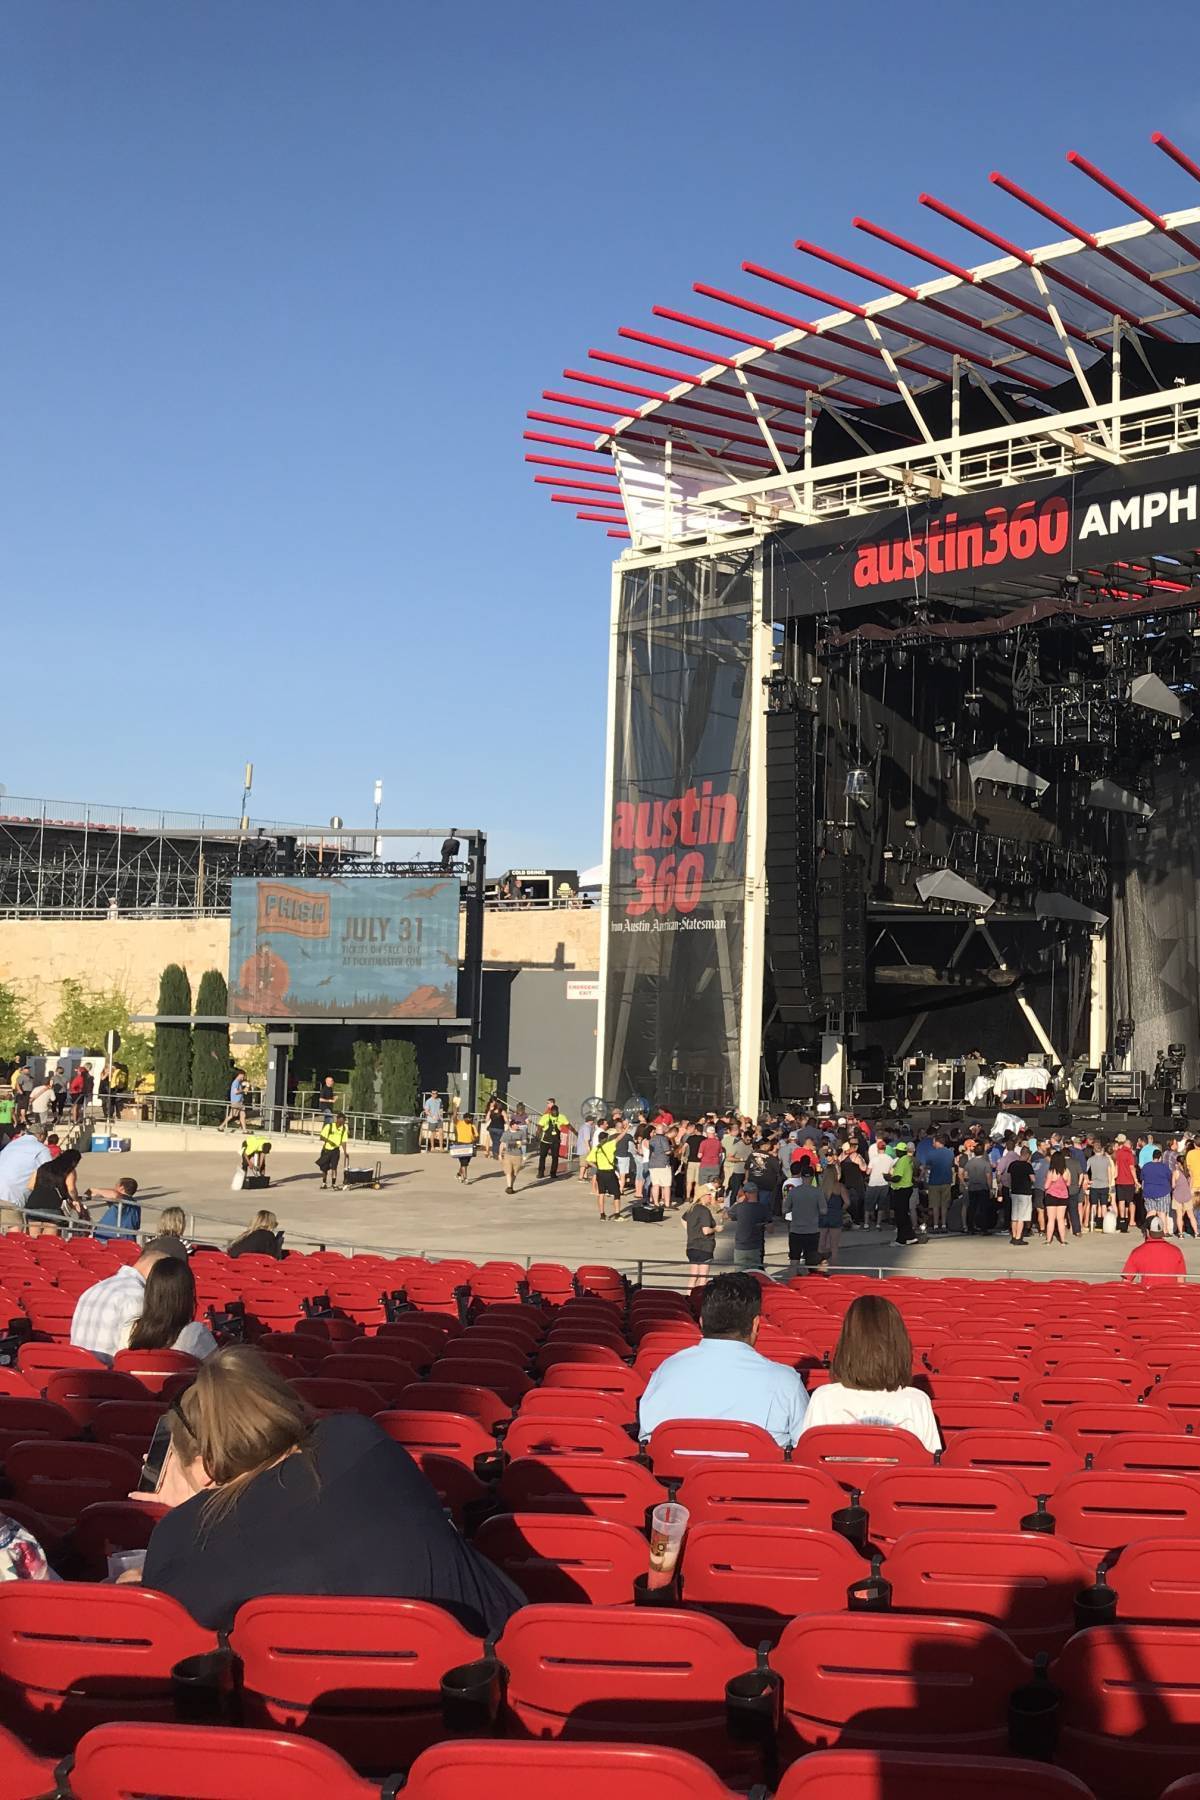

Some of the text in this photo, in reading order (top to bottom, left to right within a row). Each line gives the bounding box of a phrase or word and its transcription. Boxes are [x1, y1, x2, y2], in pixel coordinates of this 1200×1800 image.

[854, 496, 1069, 588] austin360
[613, 780, 738, 849] austin
[265, 894, 325, 924] PHISH
[624, 851, 705, 916] 360
[342, 917, 423, 942] JULY 31
